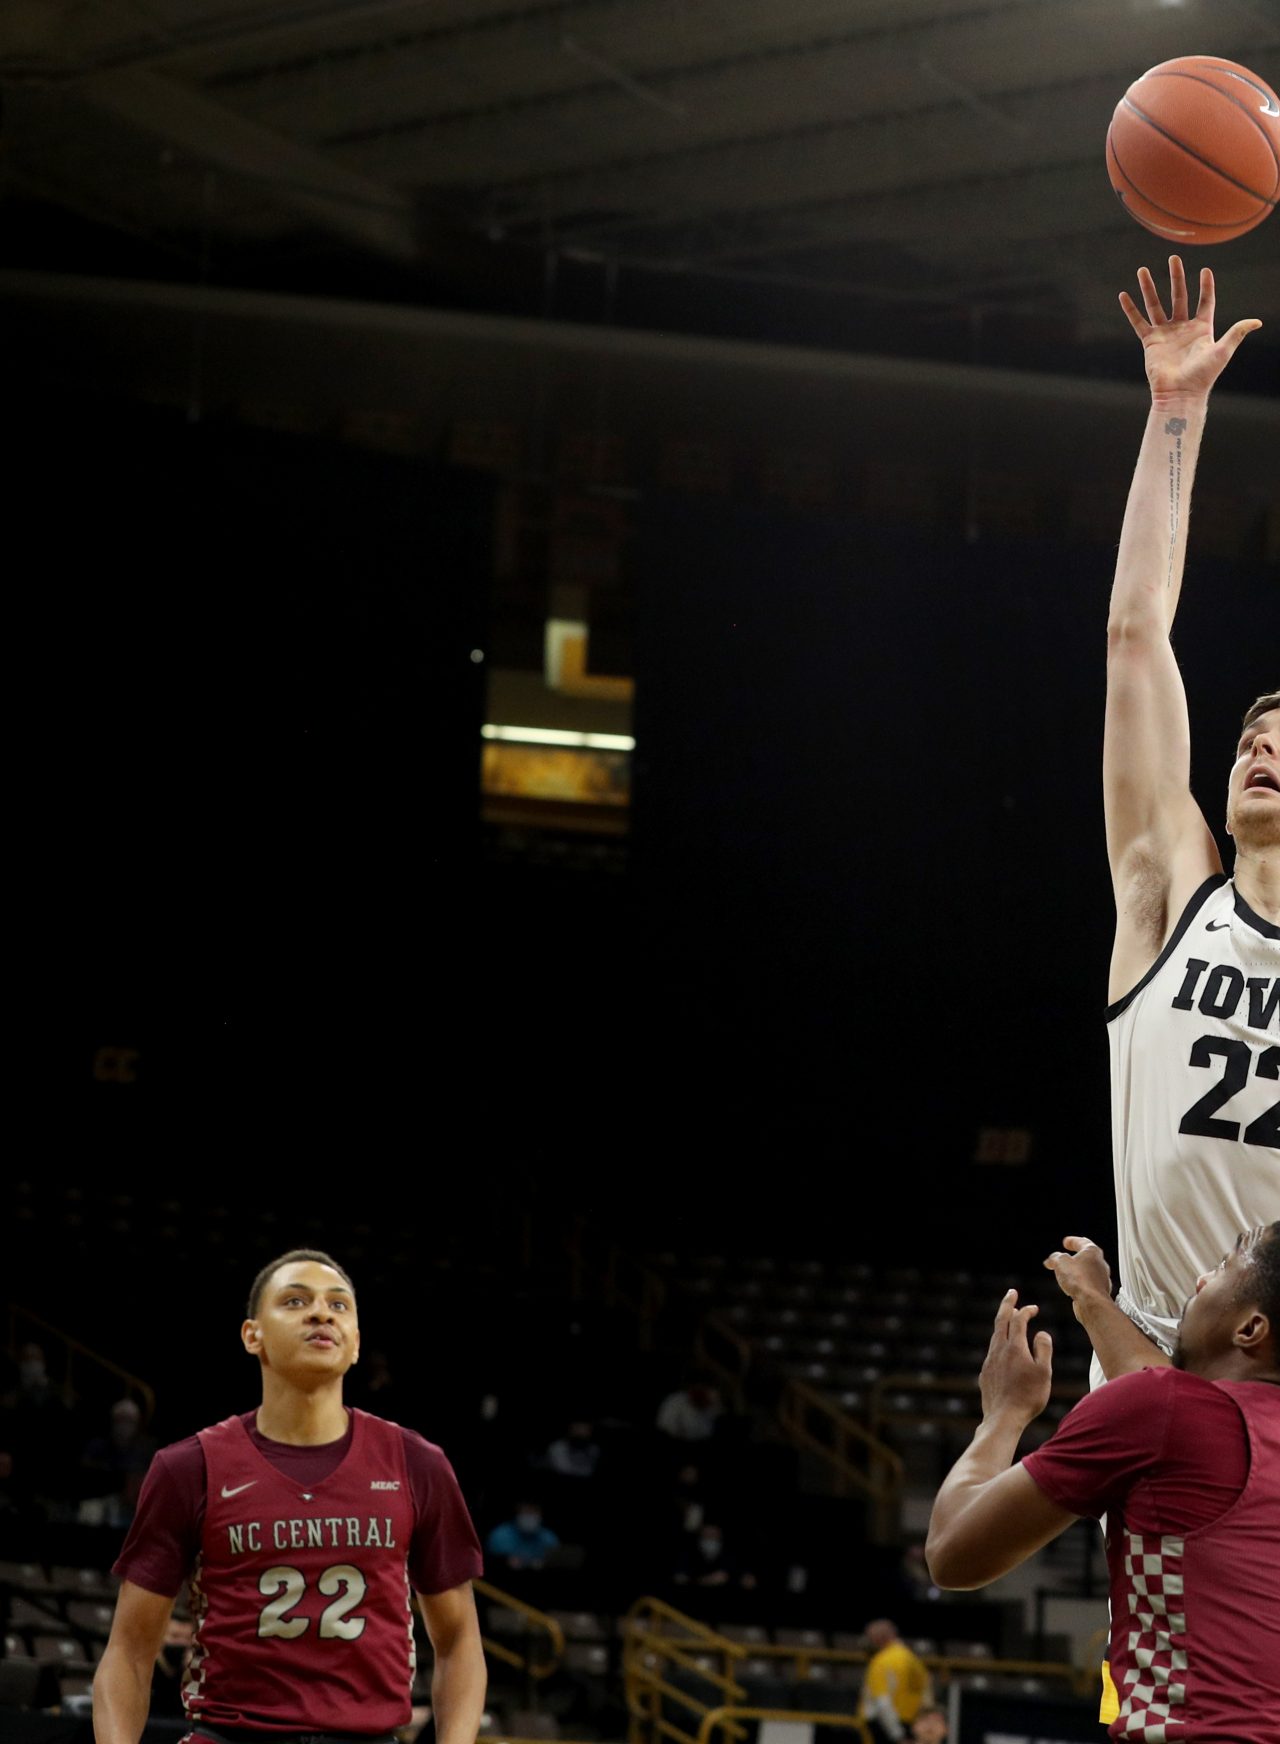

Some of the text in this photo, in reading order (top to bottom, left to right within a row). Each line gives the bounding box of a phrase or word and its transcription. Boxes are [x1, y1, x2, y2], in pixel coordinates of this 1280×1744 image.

[370, 1480, 400, 1490] MEAC
[228, 1517, 396, 1554] NC CENTRAL
[258, 1564, 367, 1640] 22
